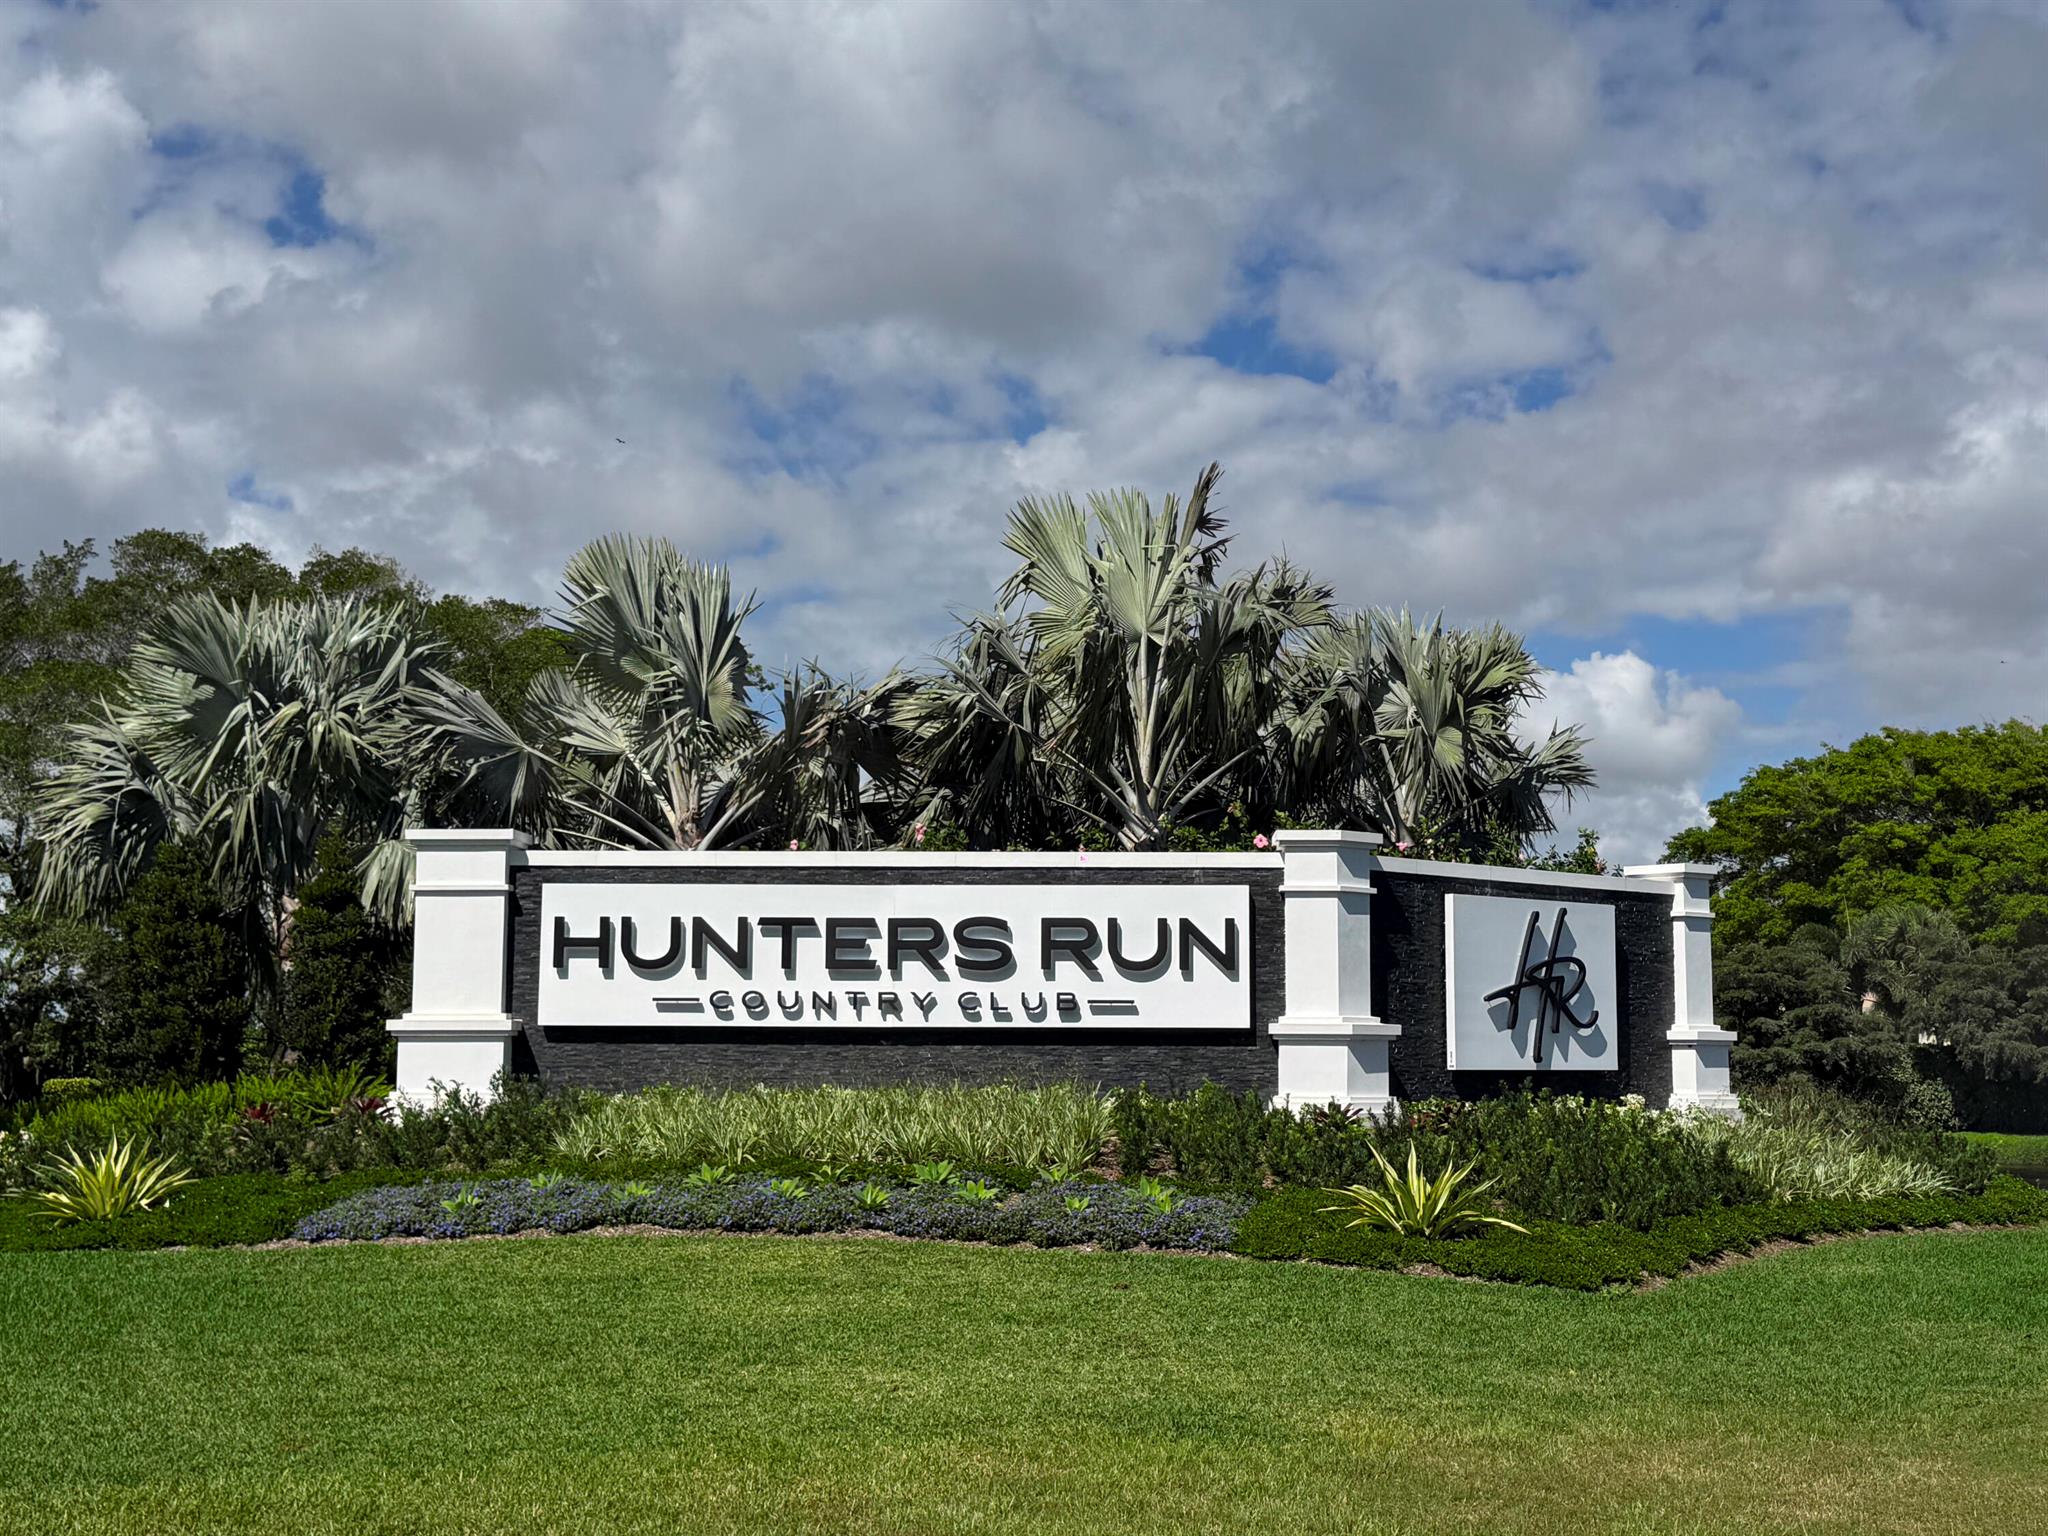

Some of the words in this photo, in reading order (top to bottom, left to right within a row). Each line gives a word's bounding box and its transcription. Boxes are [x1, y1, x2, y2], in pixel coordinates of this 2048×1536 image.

[553, 916, 1012, 971] HUNTERS
[1041, 917, 1238, 972] RUN
[709, 990, 935, 1012] COUNTRY
[958, 991, 1078, 1012] CLUB
[1483, 907, 1599, 1063] HR
